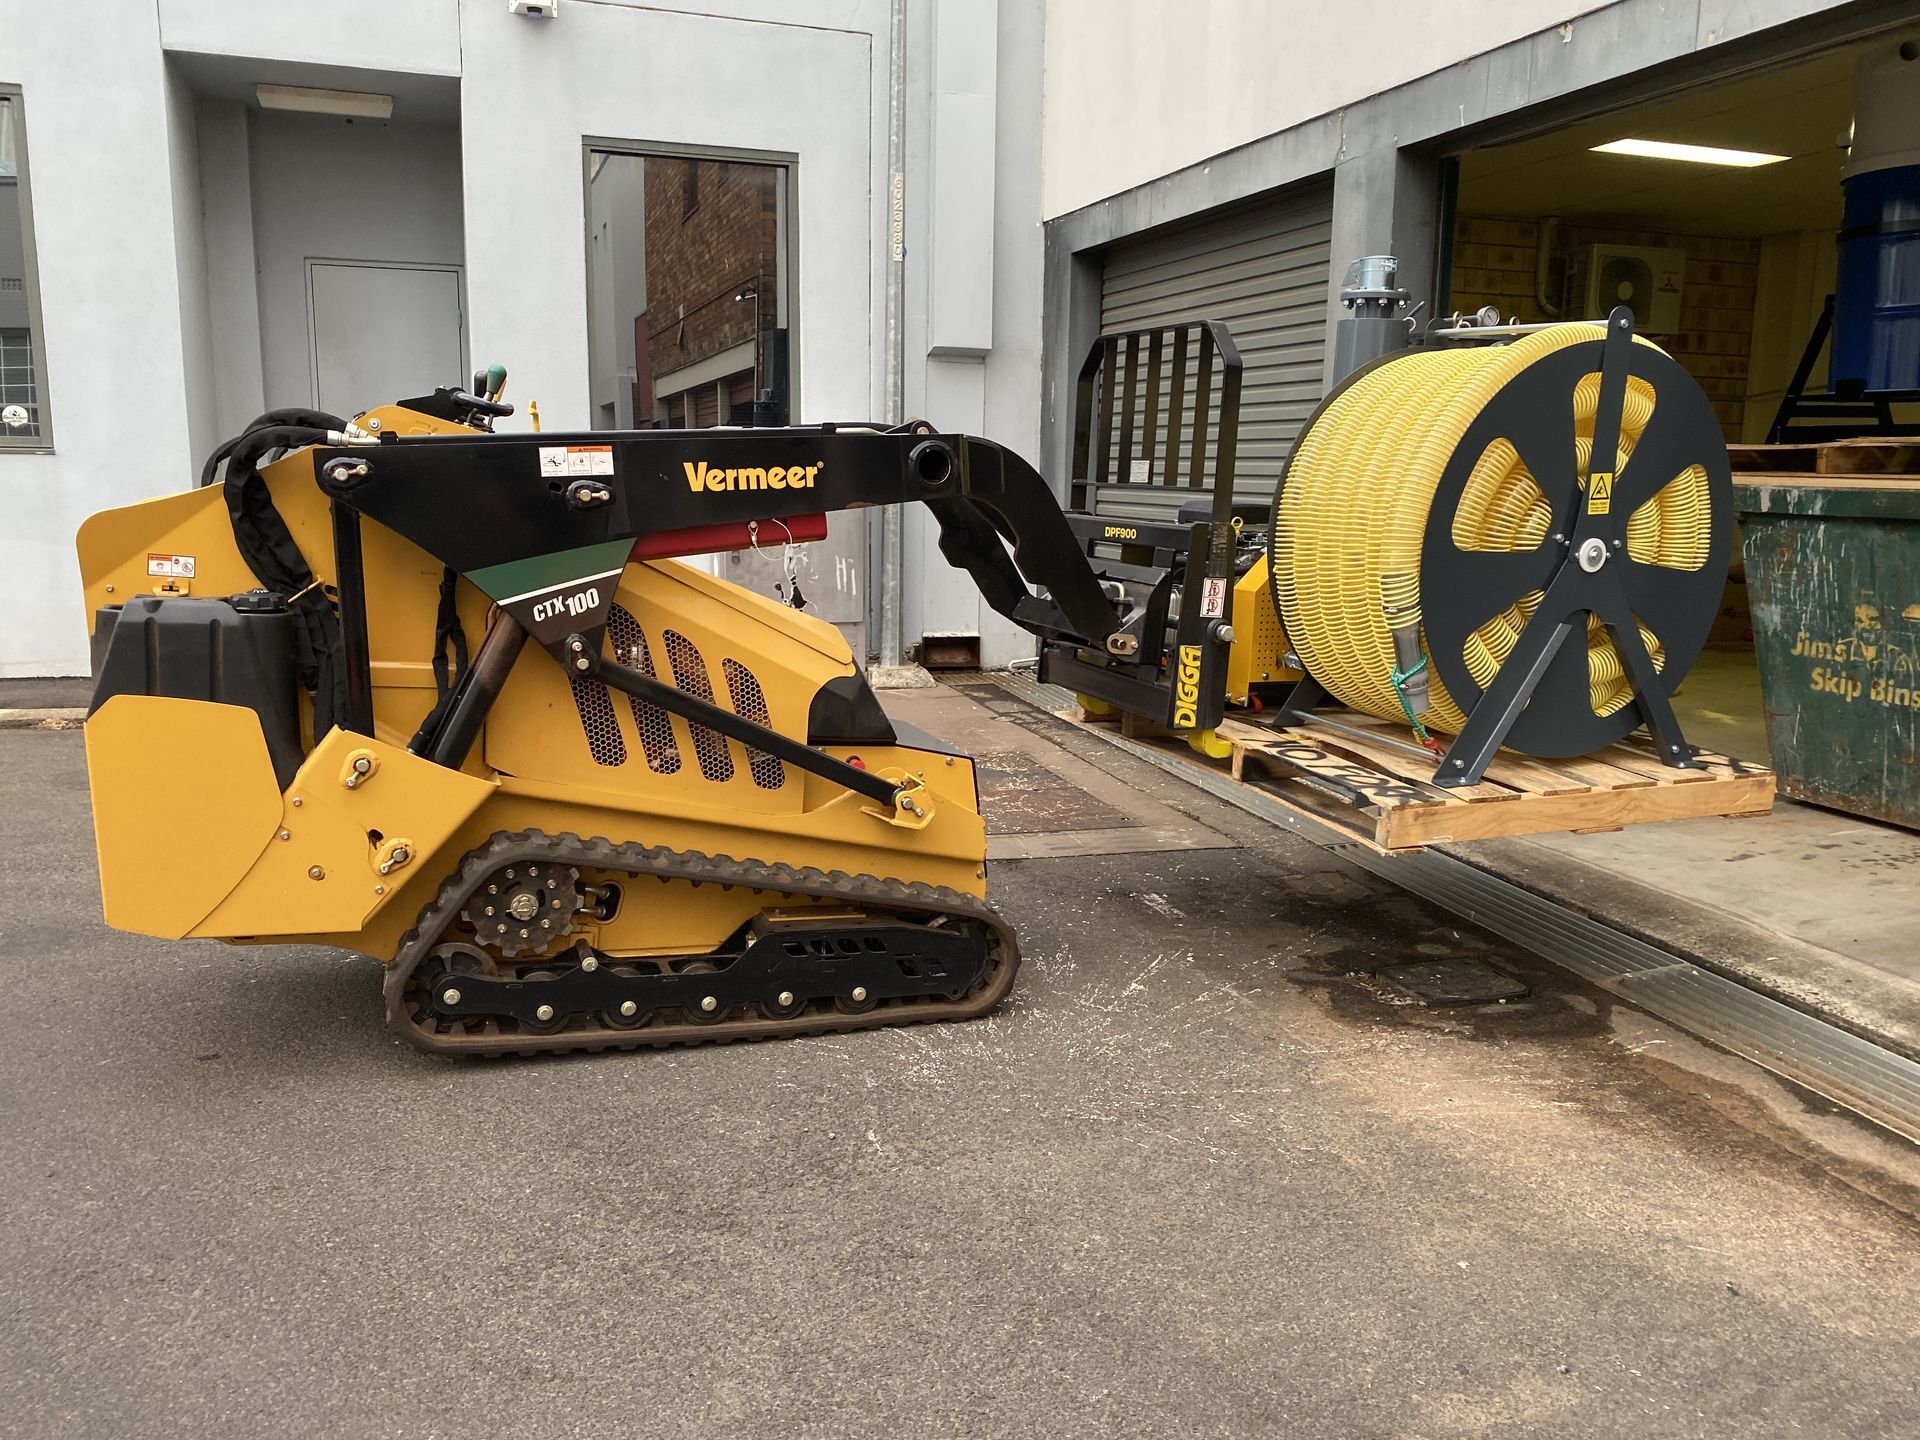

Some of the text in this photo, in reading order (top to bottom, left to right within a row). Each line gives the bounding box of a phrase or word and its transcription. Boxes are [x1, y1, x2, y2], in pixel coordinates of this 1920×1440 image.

[1105, 526, 1137, 540] DPF900
[834, 555, 857, 596] Hi
[1791, 631, 1847, 663] Jims
[1174, 645, 1202, 729] DIGGA
[1810, 667, 1920, 708] Skip Bins
